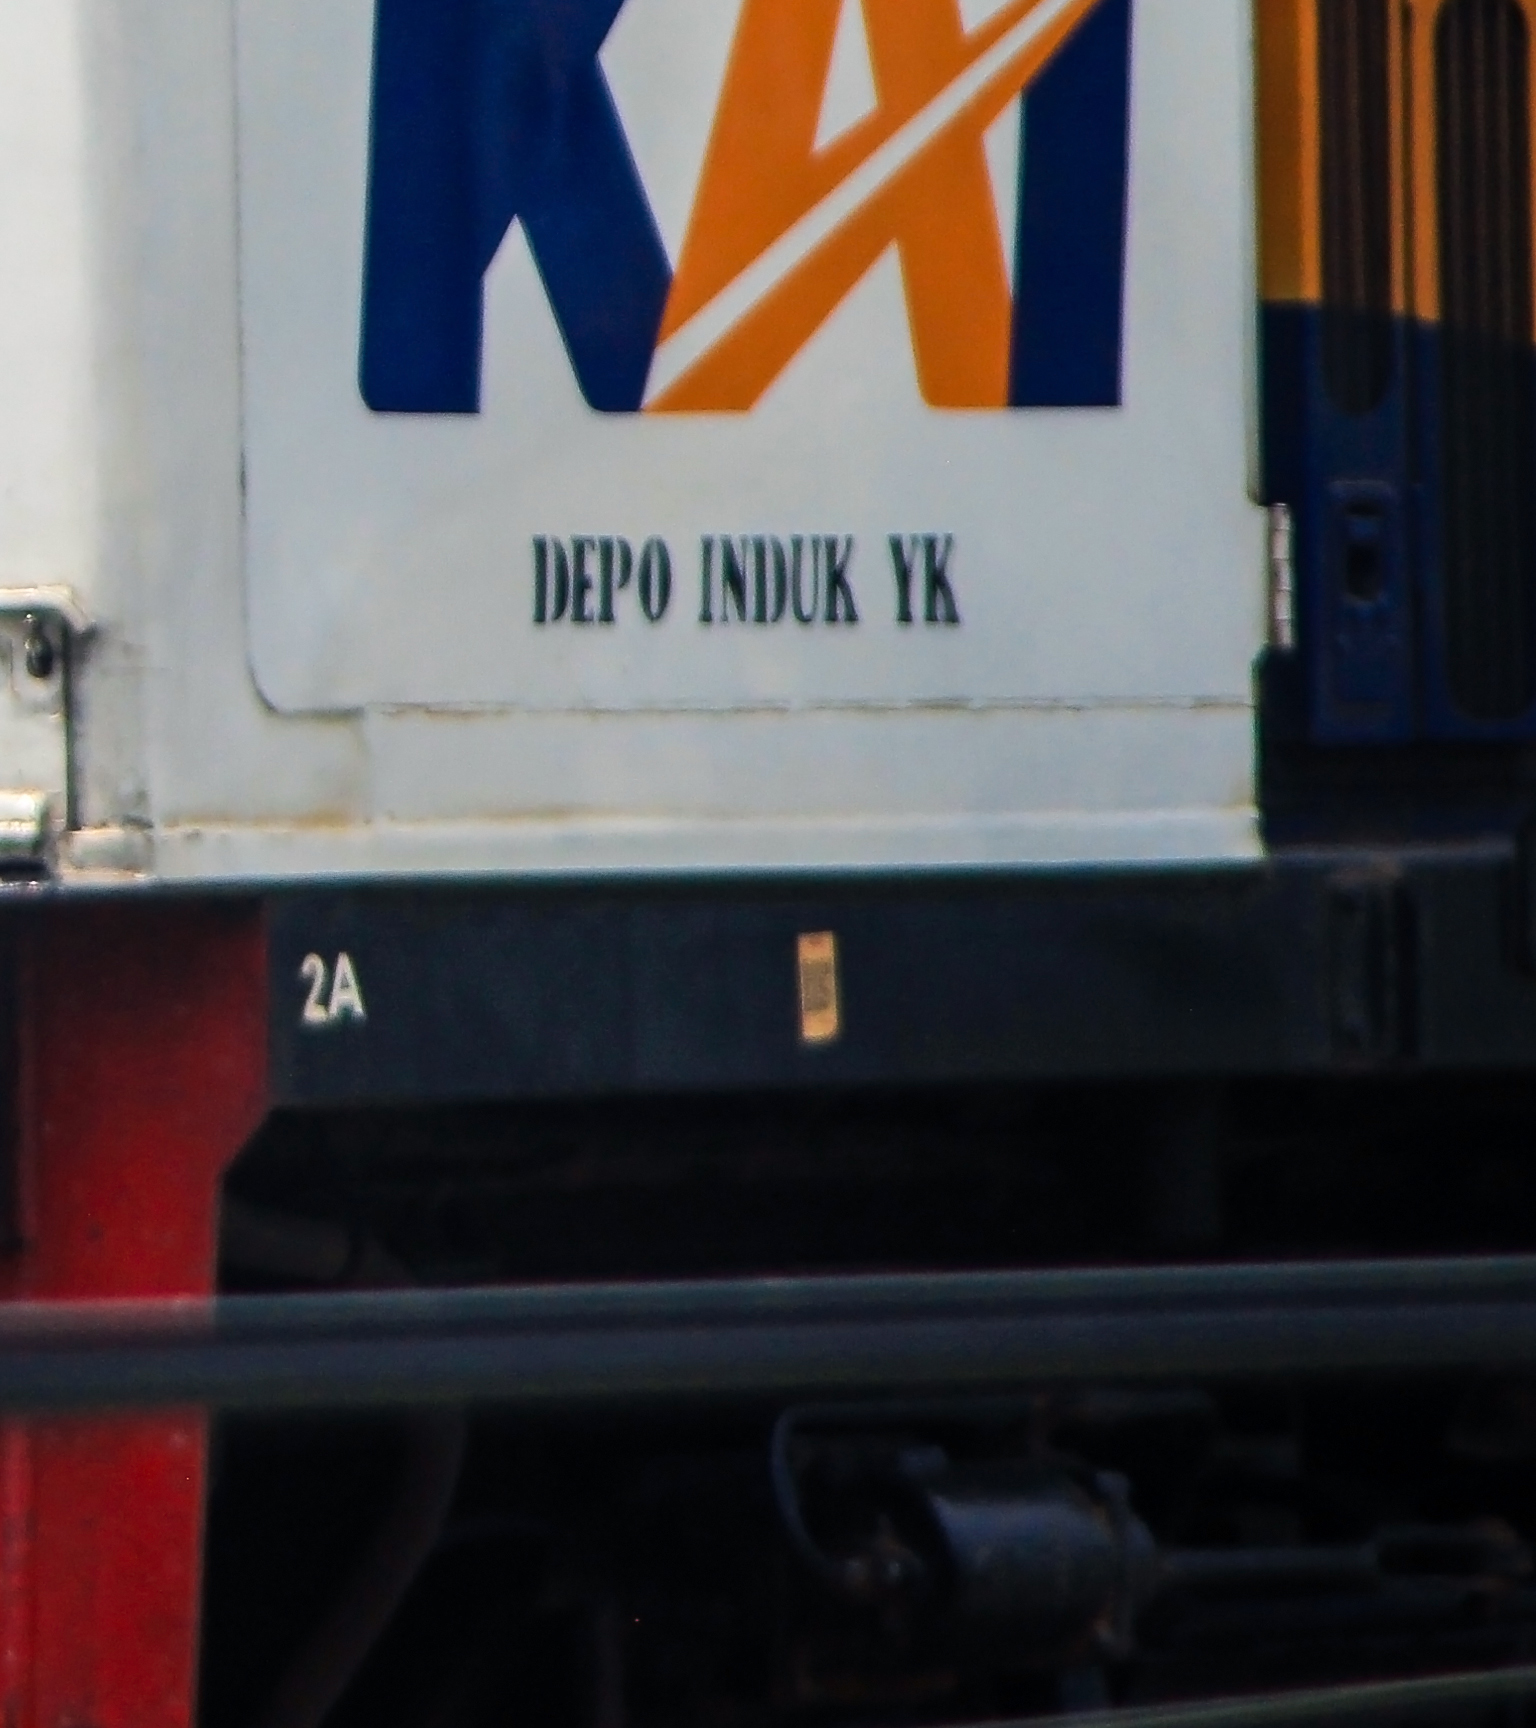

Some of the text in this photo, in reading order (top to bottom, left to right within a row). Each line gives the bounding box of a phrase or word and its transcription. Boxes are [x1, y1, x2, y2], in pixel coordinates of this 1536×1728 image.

[531, 531, 961, 624] DEPO INDUK YK
[300, 951, 366, 1023] 2A
